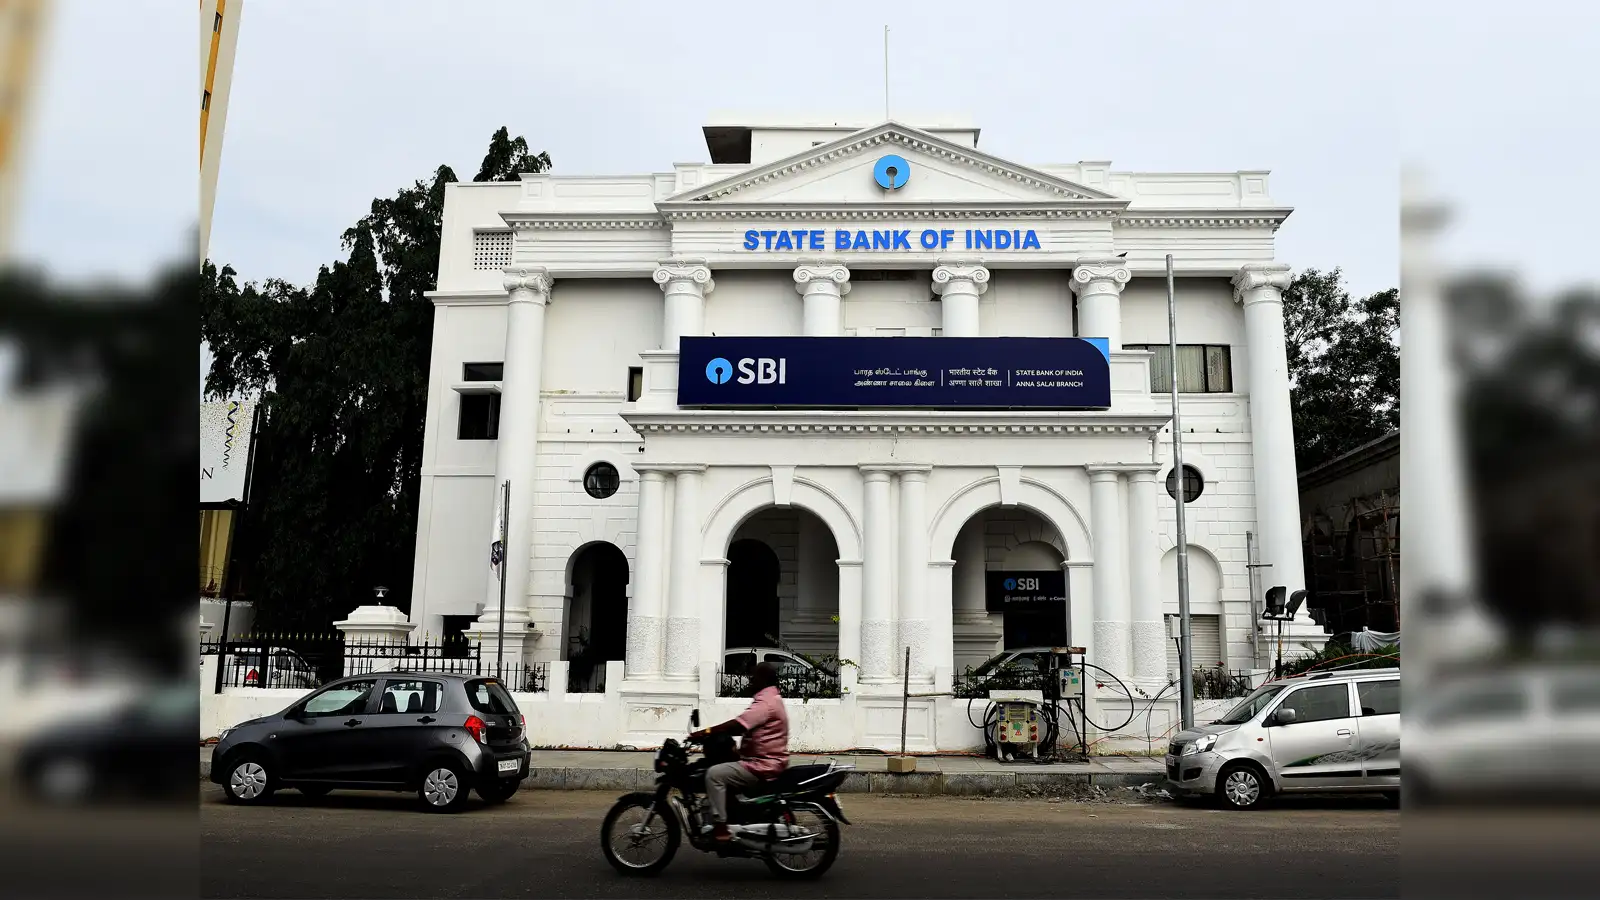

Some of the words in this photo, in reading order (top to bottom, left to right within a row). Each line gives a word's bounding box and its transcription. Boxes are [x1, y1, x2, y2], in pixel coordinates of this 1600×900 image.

[743, 230, 825, 250] STATE
[835, 230, 912, 250] BANK
[919, 229, 955, 249] OF
[965, 230, 1041, 249] INDIA
[737, 357, 787, 385] SBI
[853, 369, 874, 377] பாரத
[903, 368, 928, 378] பாங்கு
[948, 368, 971, 376] भारतीय
[972, 367, 986, 376] स्टेट
[1015, 369, 1035, 377] STATE
[1036, 369, 1053, 377] BANK
[1054, 369, 1064, 377] OF
[1064, 369, 1084, 377] INDIA
[853, 379, 887, 387] அண்ணா
[913, 379, 936, 387] கிளை
[984, 379, 1003, 388] शाखा
[1015, 380, 1035, 388] ANNA
[1036, 380, 1055, 388] SALAI
[1056, 380, 1084, 388] BRANCH
[201, 467, 215, 480] N
[1017, 577, 1040, 591] SBI
